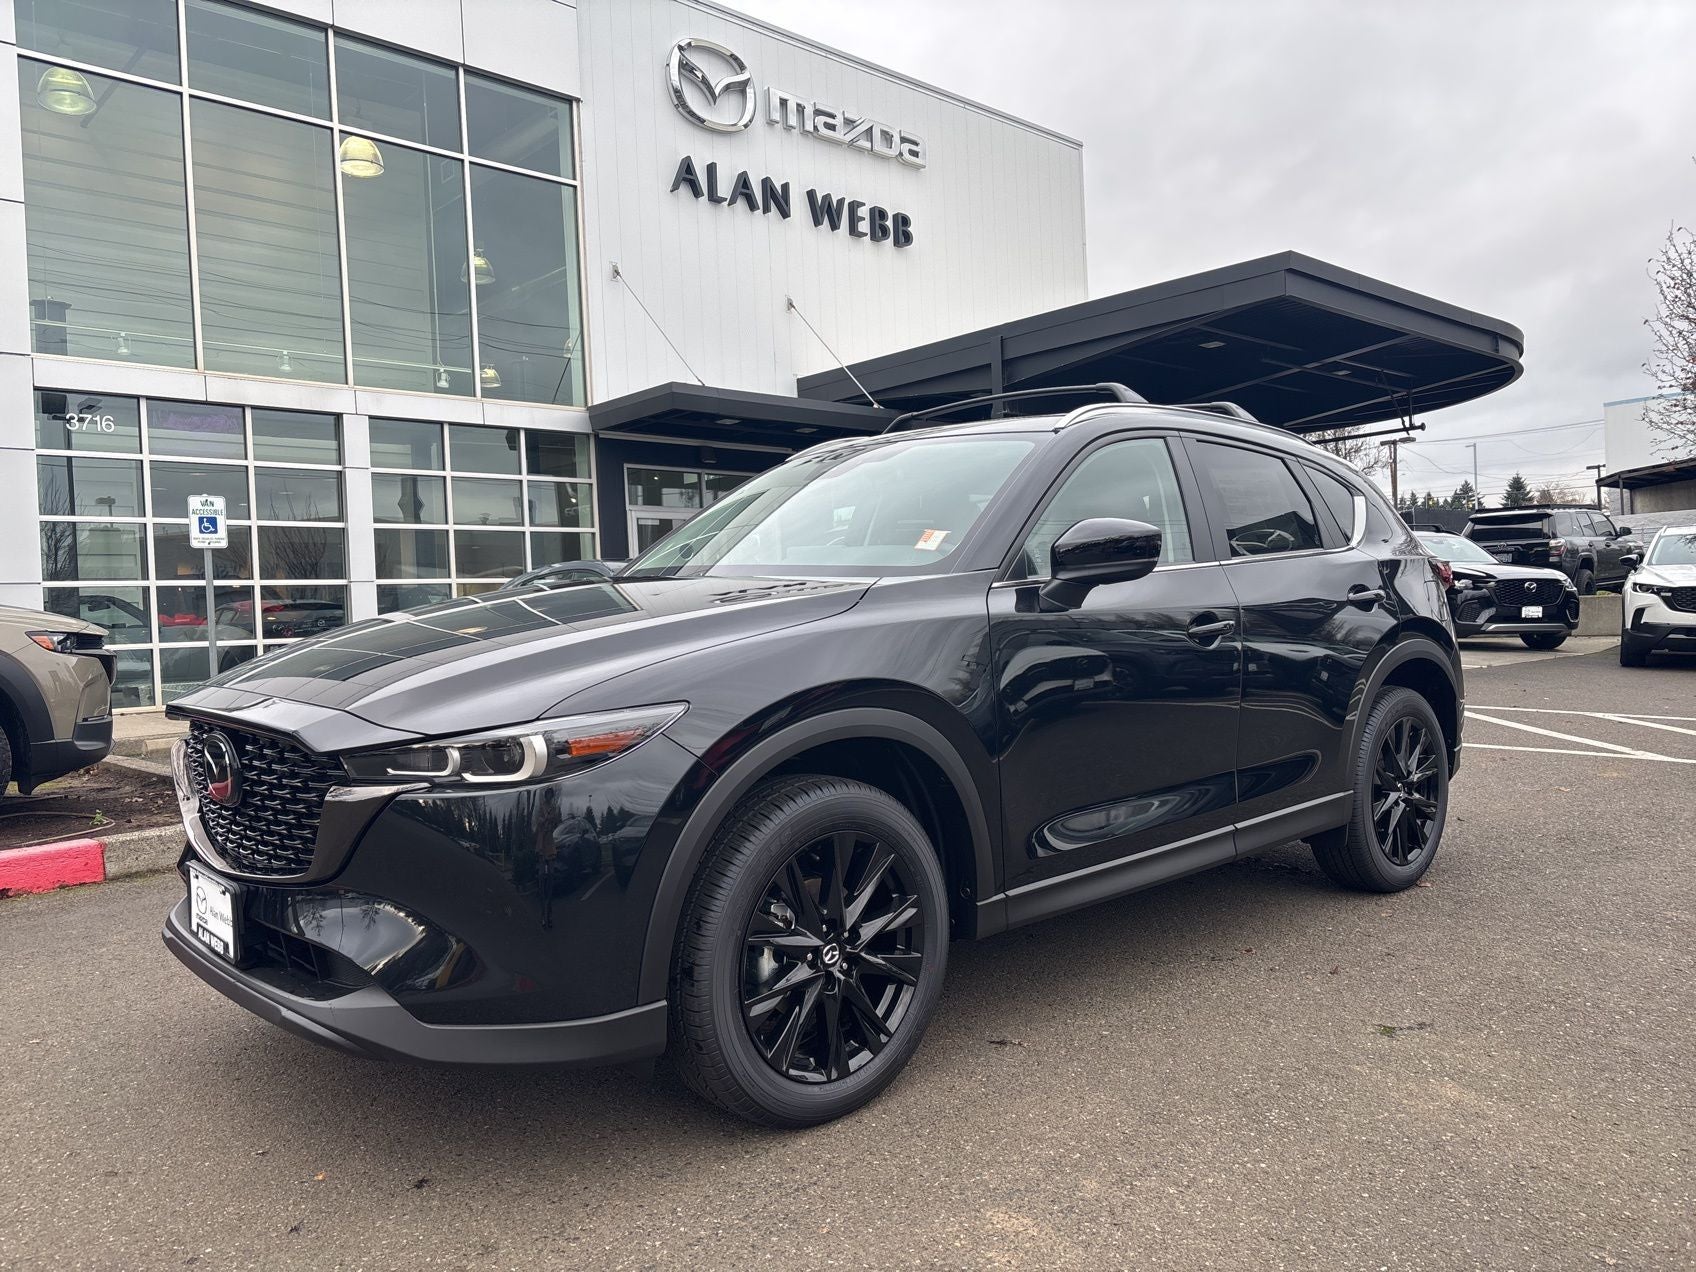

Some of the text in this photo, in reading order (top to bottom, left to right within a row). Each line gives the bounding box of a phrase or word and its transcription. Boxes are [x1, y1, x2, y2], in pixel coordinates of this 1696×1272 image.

[670, 155, 914, 248] ALAN WEBB
[65, 413, 115, 432] 3716
[200, 499, 214, 507] VAN
[191, 508, 224, 516] ACCESSIBLE
[219, 911, 233, 927] Webb
[198, 926, 224, 954] ALAN WEBB
